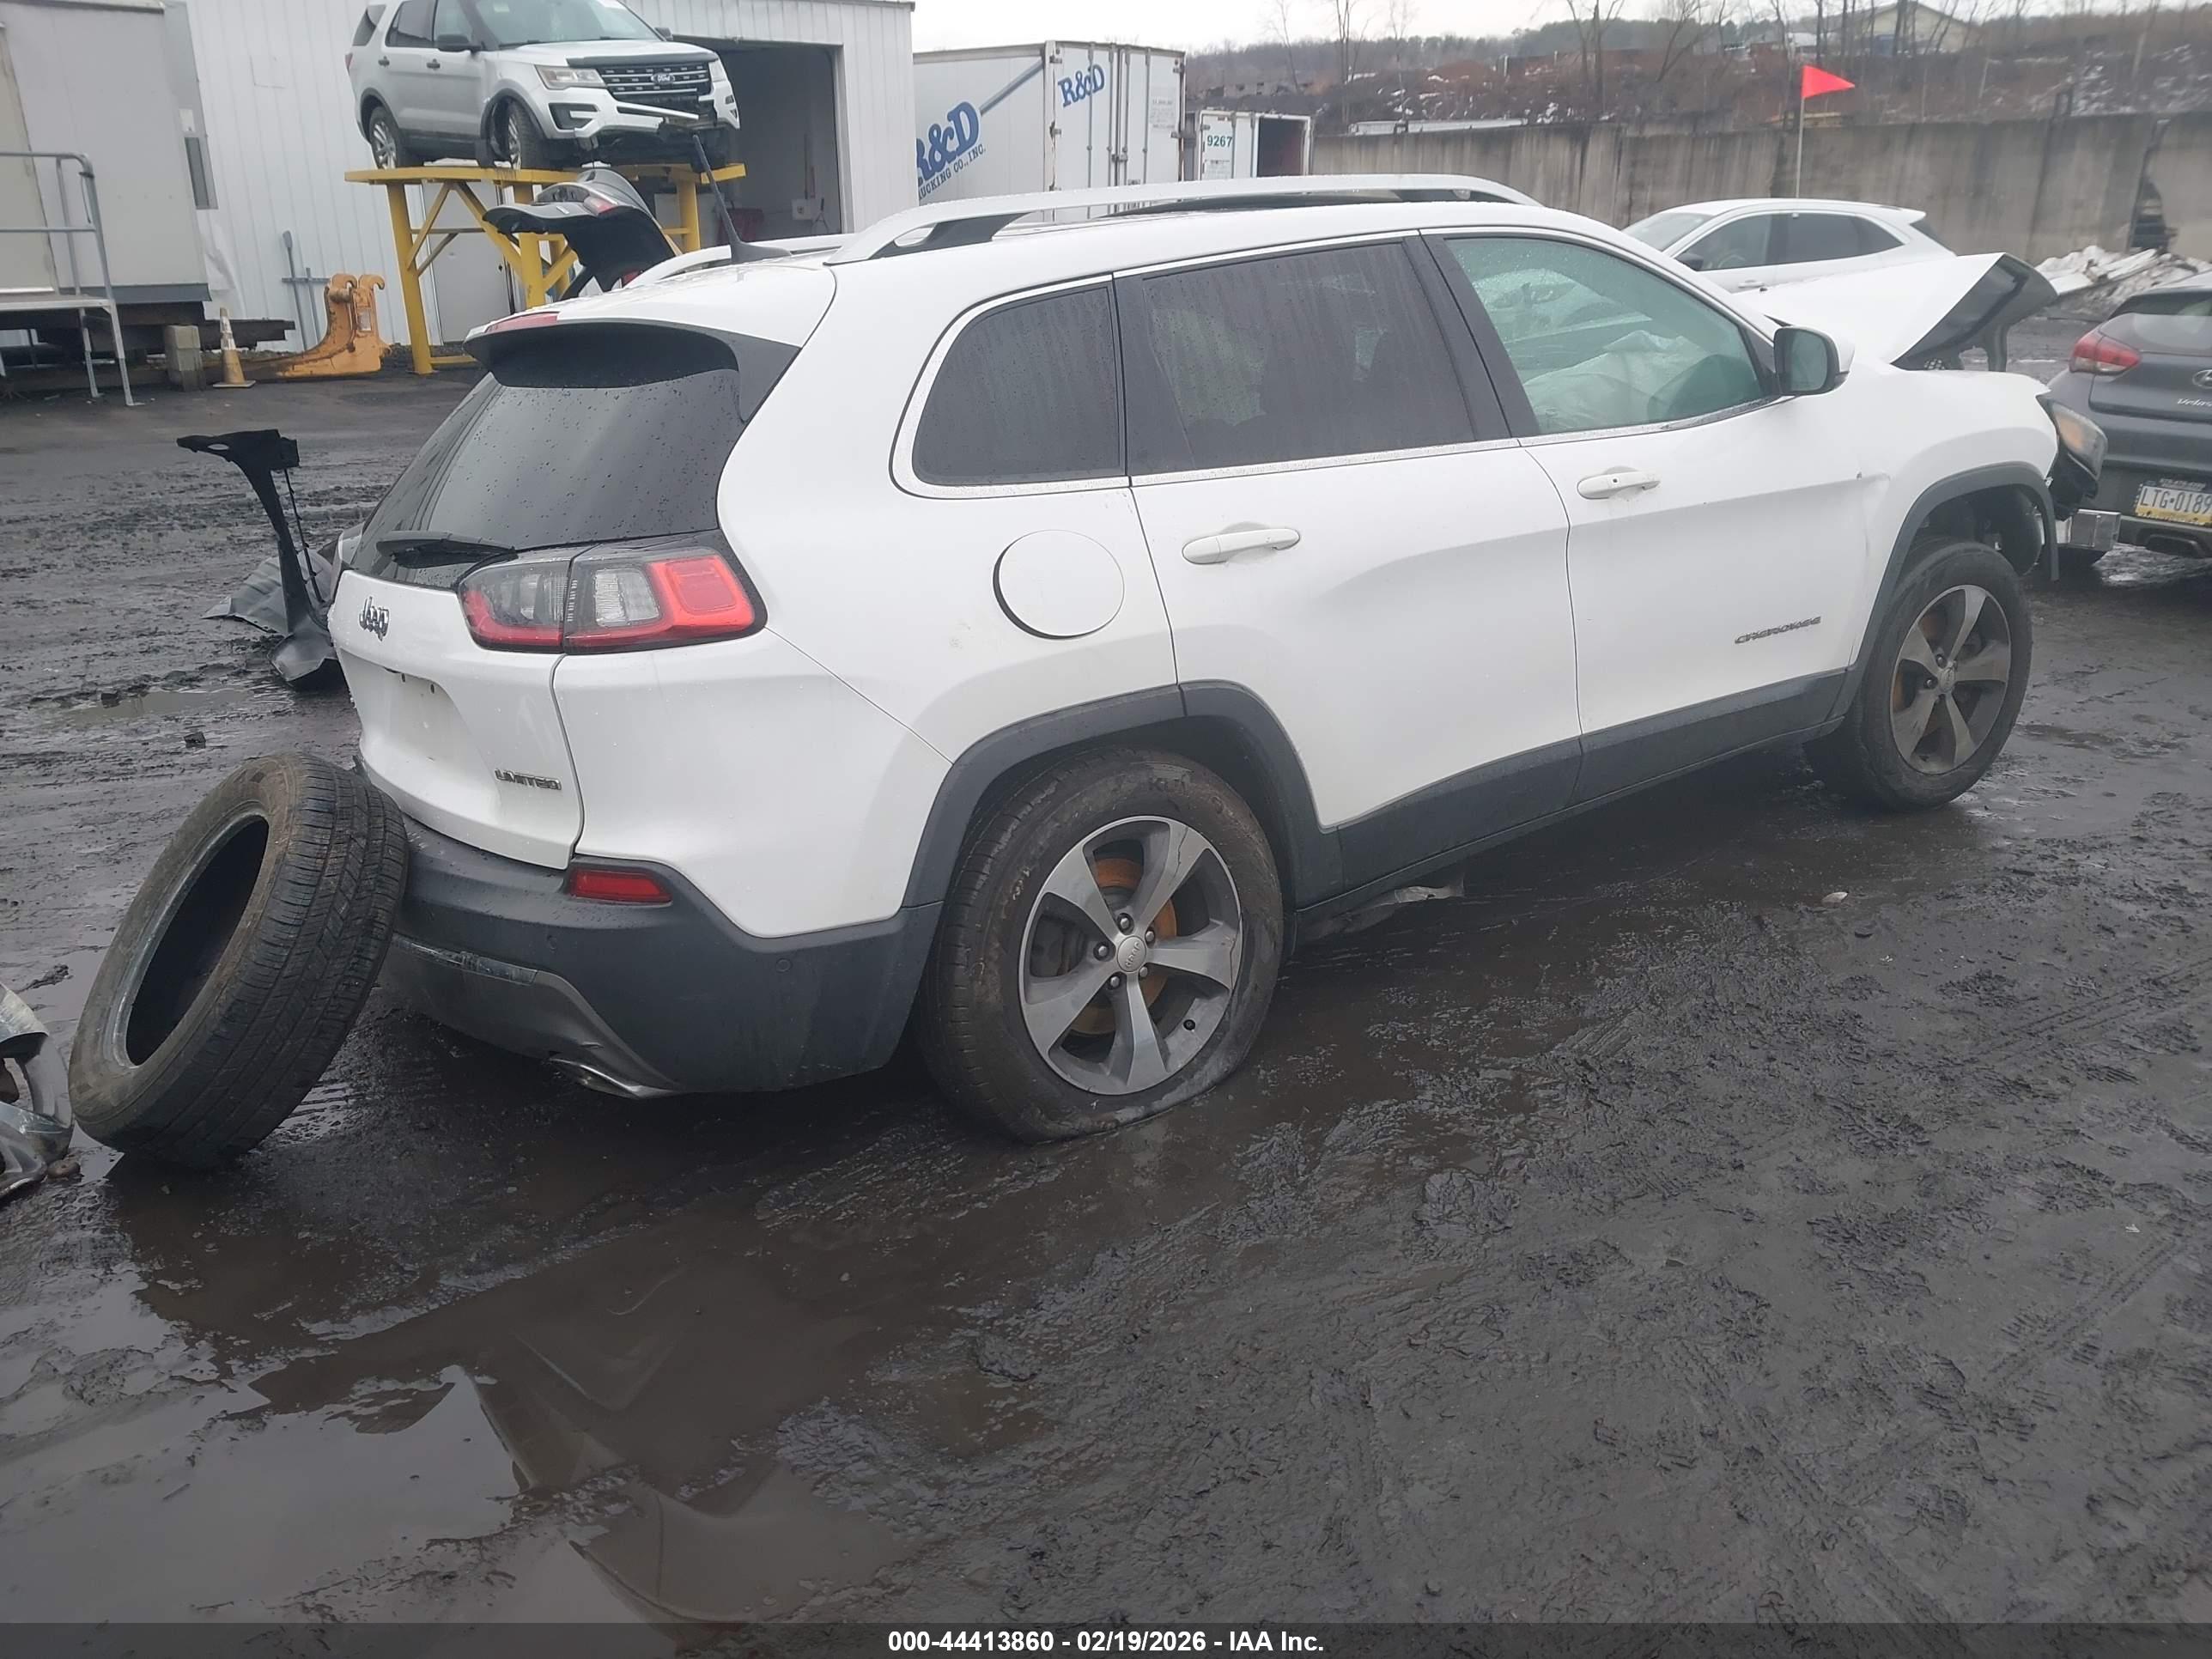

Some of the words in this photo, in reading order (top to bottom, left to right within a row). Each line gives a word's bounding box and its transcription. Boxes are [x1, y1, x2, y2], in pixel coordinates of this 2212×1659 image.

[1057, 64, 1105, 107] R&D
[1206, 135, 1233, 148] 9267
[359, 595, 390, 642] Jeep
[1735, 616, 1821, 645] CHEROKEE
